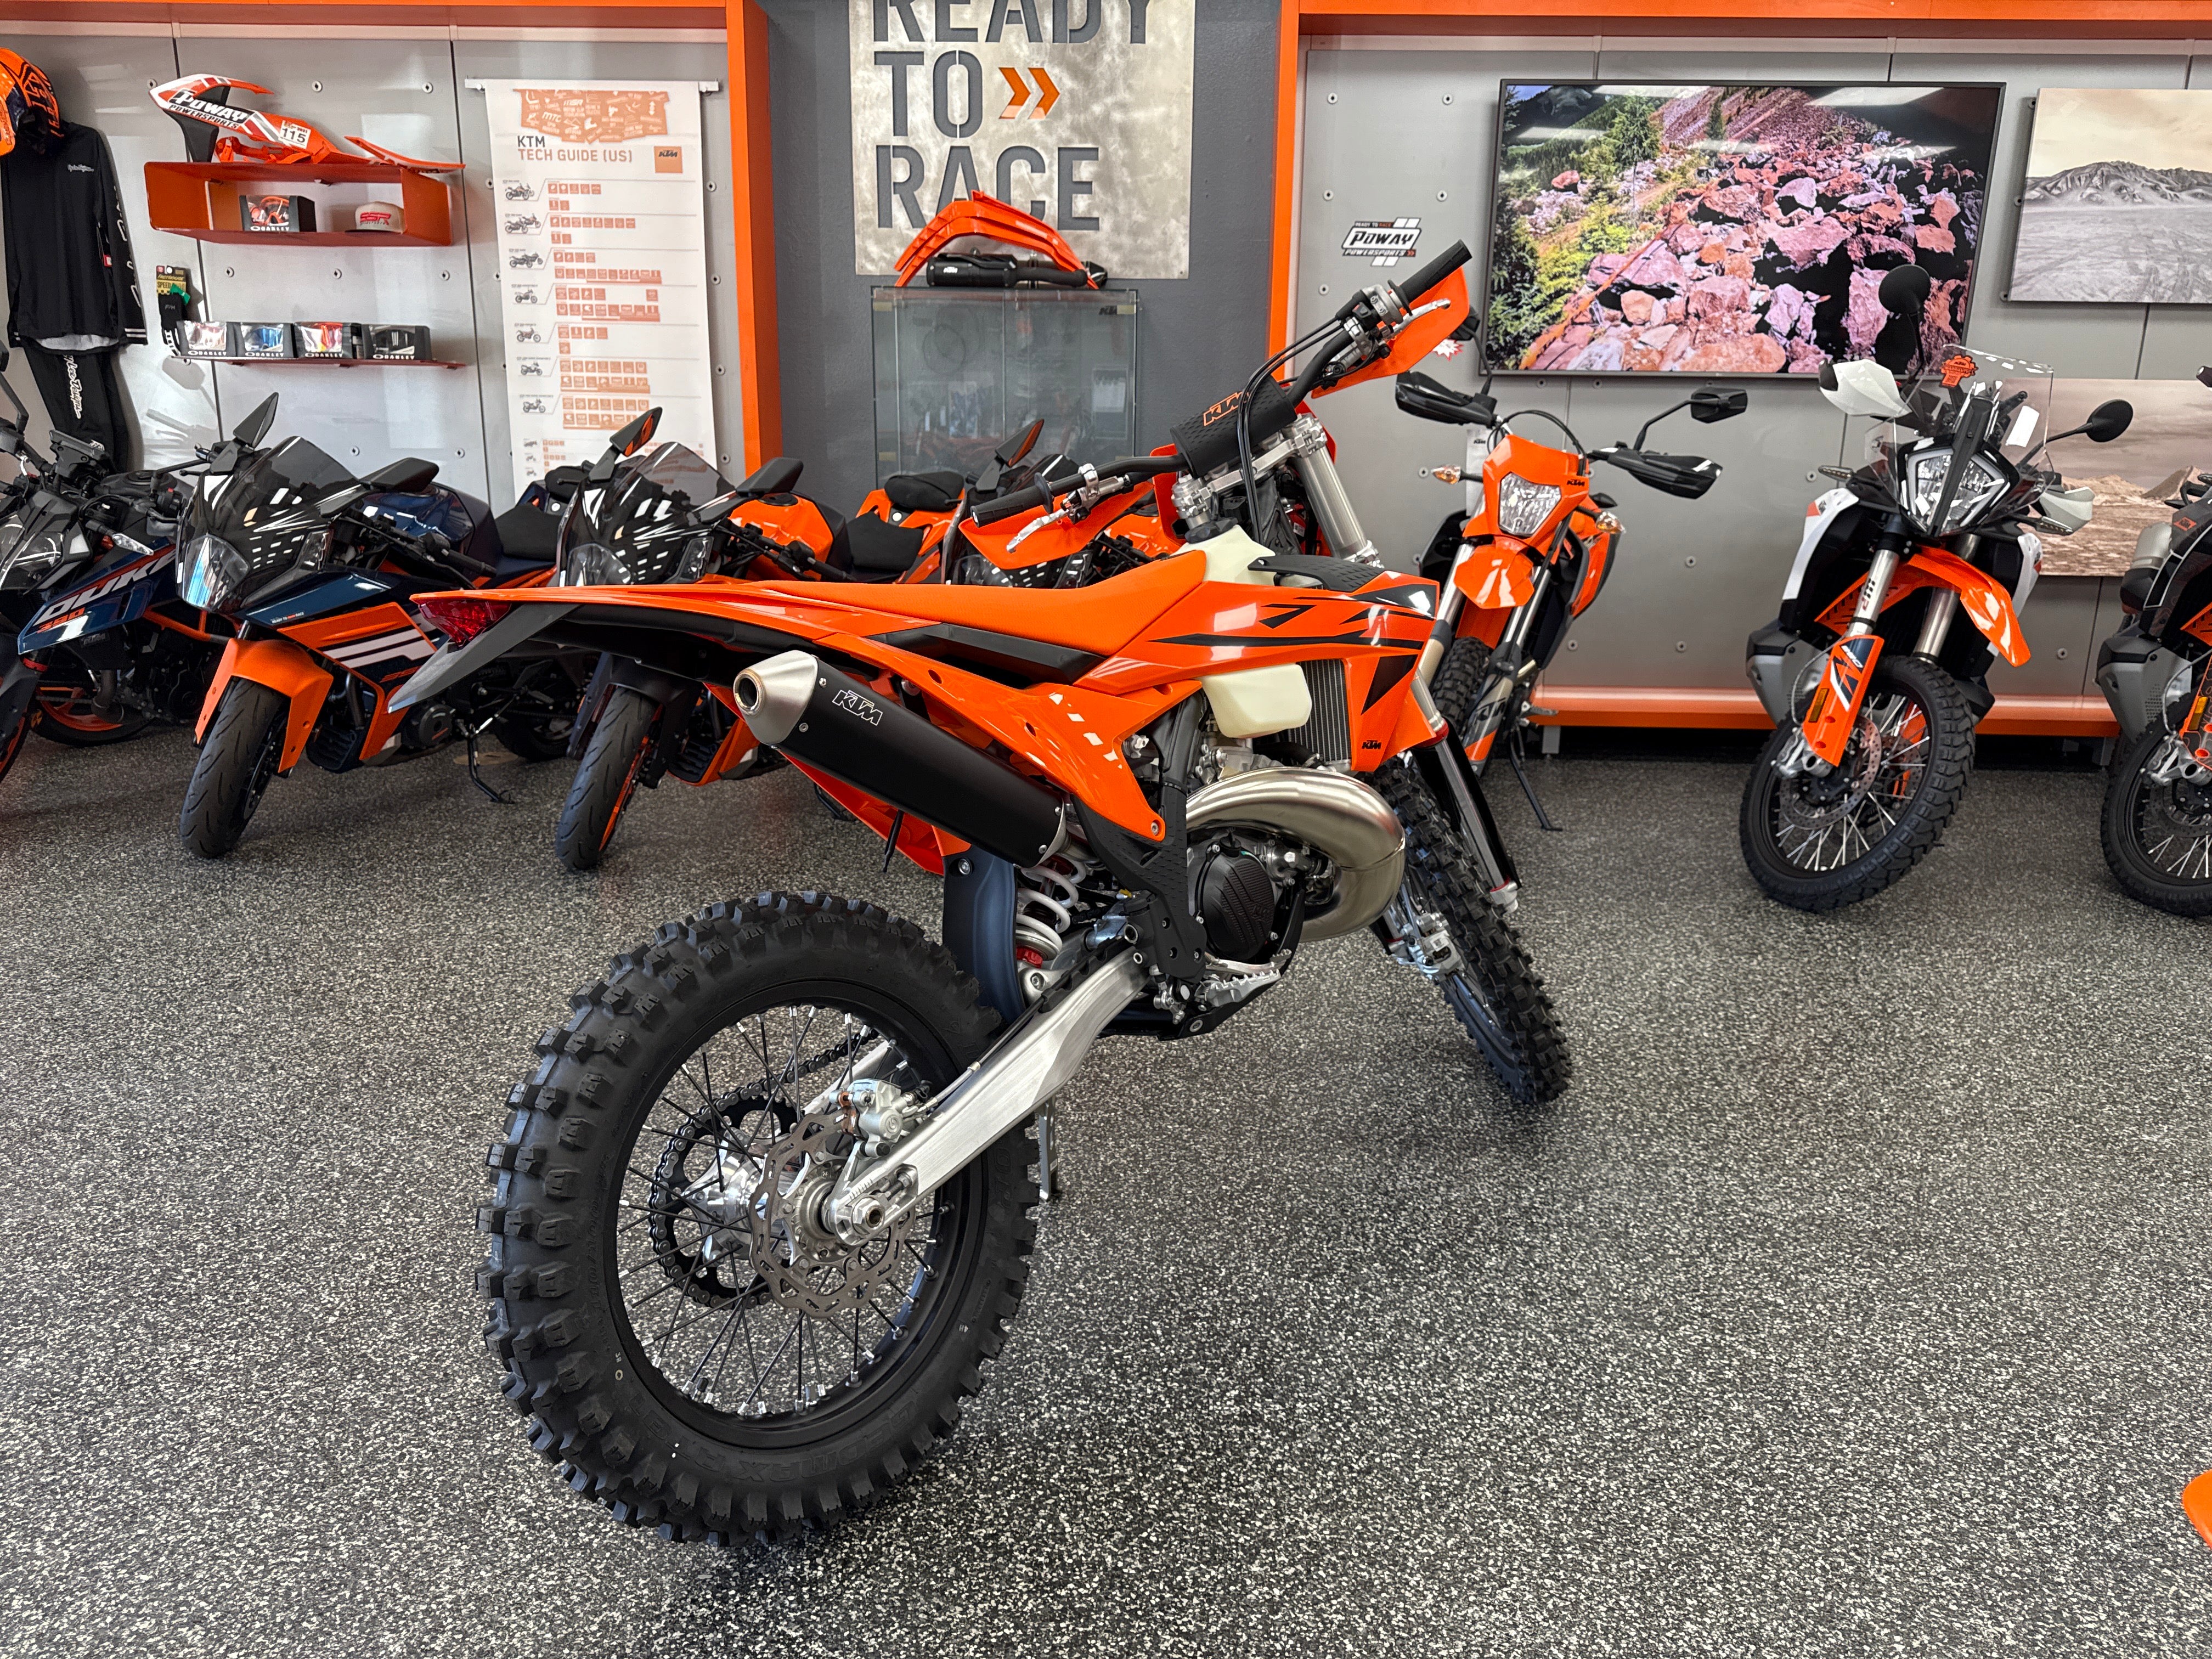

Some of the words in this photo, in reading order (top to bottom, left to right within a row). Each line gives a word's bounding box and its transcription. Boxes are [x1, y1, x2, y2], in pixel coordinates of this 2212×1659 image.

[874, 50, 983, 138] TO
[173, 89, 246, 122] POWAY
[169, 104, 238, 129] POWERSPORTS
[282, 128, 306, 143] 115
[517, 136, 545, 148] KTM
[518, 149, 552, 161] TECH
[557, 149, 598, 162] GUIDE
[876, 145, 1099, 230] RACE
[1350, 231, 1414, 245] POWAY
[1566, 479, 1585, 487] KTM
[36, 607, 86, 634] 390
[832, 689, 883, 726] KTM
[1362, 740, 1382, 749] KTM
